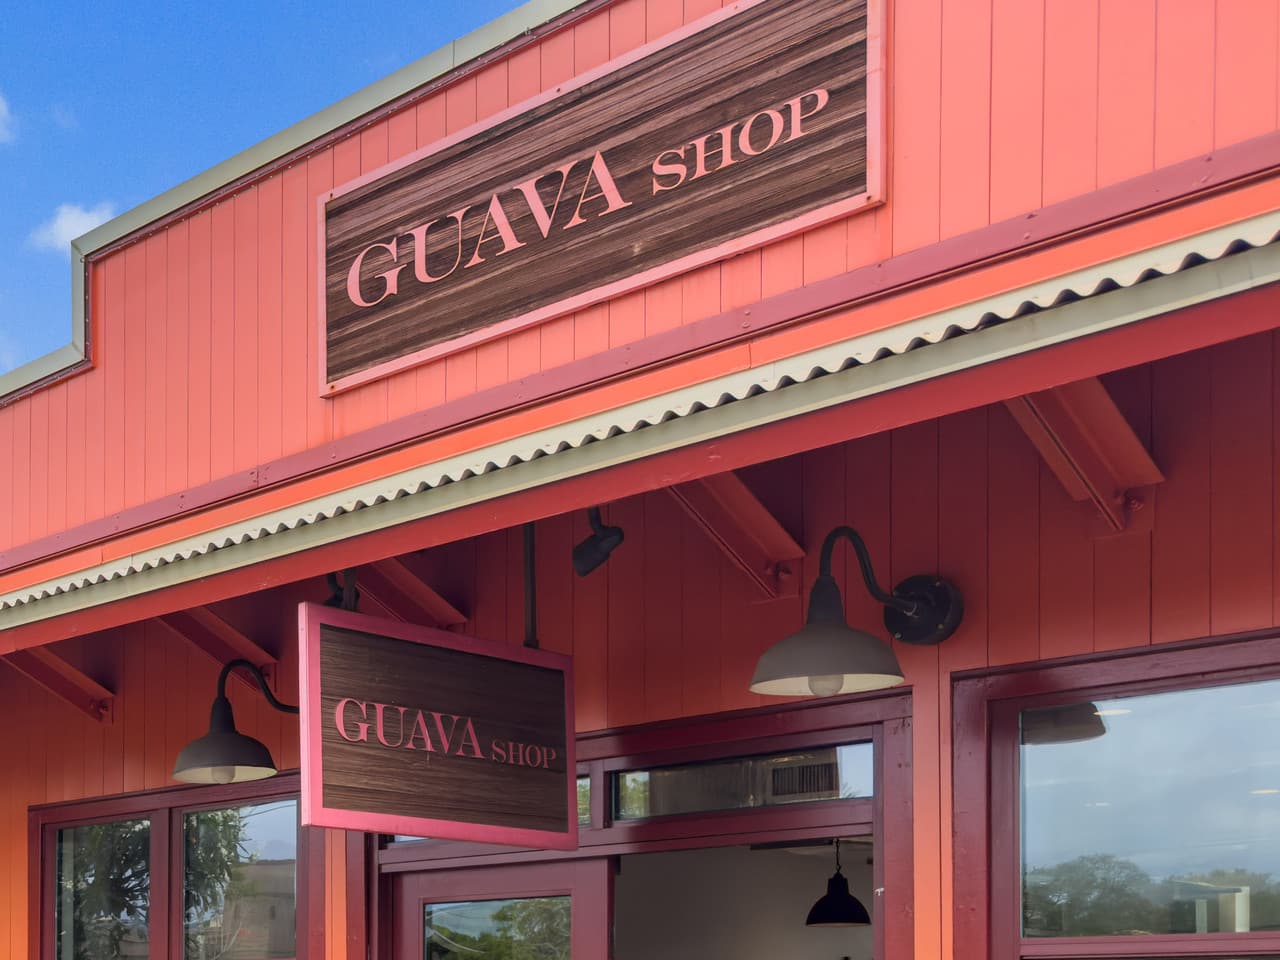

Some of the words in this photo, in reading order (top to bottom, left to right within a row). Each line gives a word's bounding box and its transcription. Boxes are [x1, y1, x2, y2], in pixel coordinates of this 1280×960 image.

[346, 150, 633, 307] GUAVA
[652, 88, 830, 196] SHOP
[335, 697, 486, 759] GUAVA
[491, 738, 557, 769] SHOP
